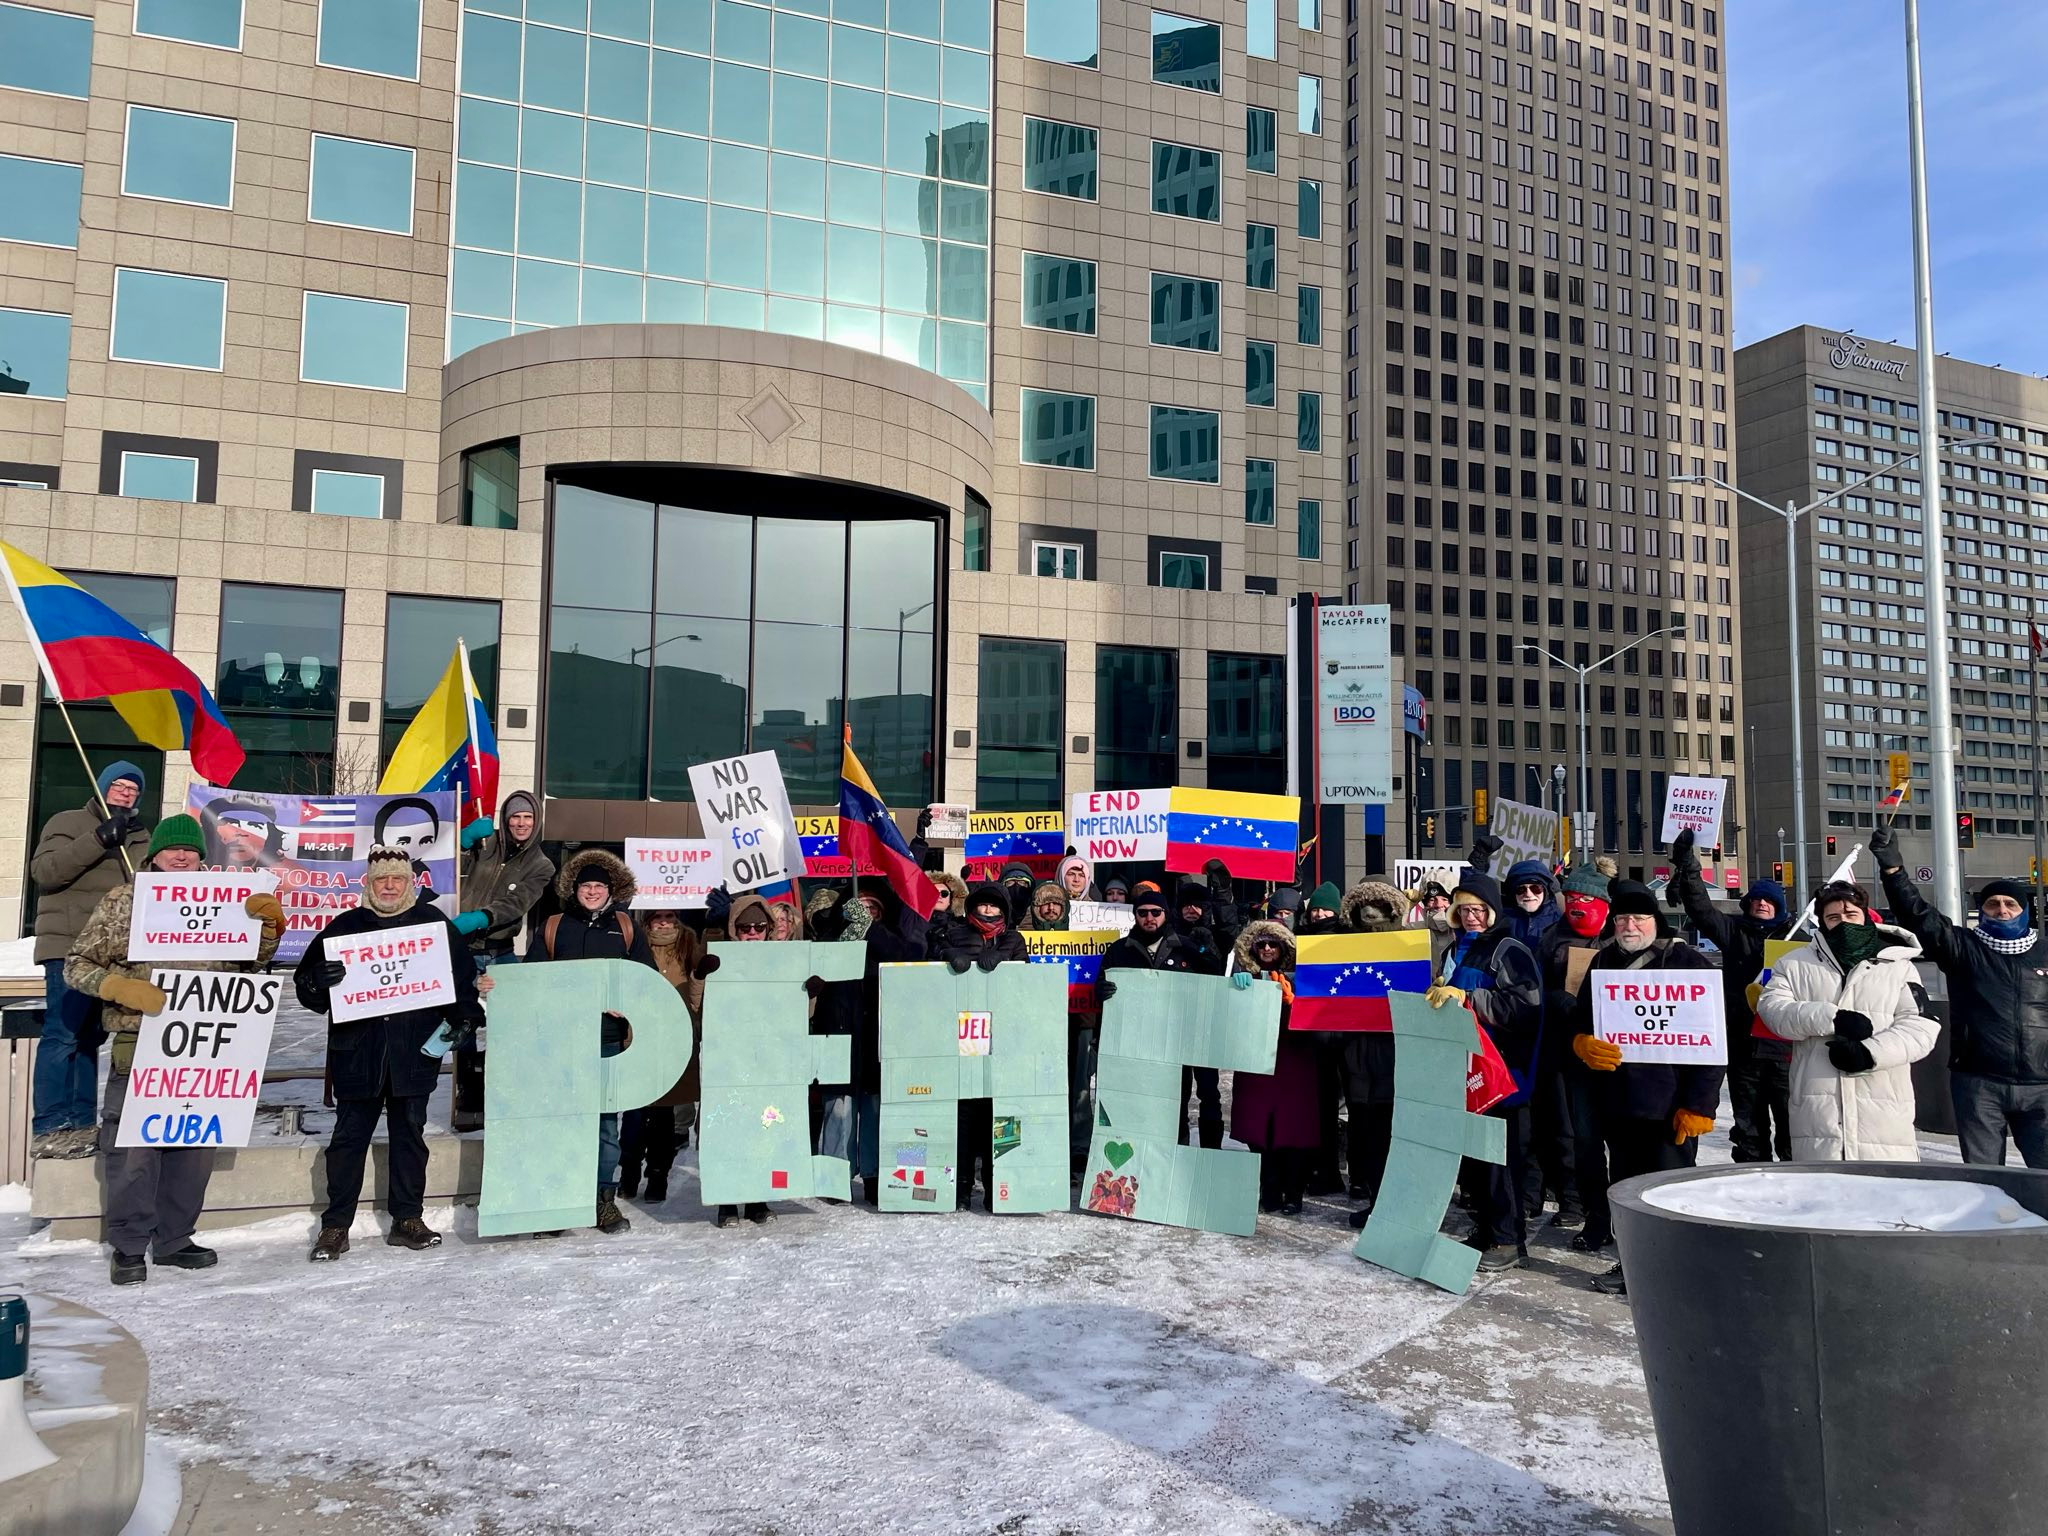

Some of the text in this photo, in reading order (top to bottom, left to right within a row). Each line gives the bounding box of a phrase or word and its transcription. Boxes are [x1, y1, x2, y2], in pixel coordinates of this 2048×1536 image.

[1830, 335, 1910, 381] Fairmont
[1322, 610, 1363, 618] TAYLOR
[1322, 617, 1387, 626] McCAFFREY
[1339, 706, 1376, 719] BDO
[712, 759, 749, 789] NO
[1325, 785, 1375, 797] UPTOWN
[1672, 788, 1717, 801] CARNEY:
[707, 786, 768, 823] WAR
[1089, 791, 1140, 812] END
[1672, 804, 1713, 815] RESPECT
[970, 815, 1058, 832] HANDS OFF!
[1494, 801, 1555, 849] DEMAND
[1669, 813, 1713, 824] INTERNATIONAL
[1678, 821, 1702, 832] LAWS
[732, 827, 764, 849] for
[304, 842, 347, 851] M-26-7
[1090, 838, 1138, 859] NOW
[636, 850, 711, 862] TRUMP
[659, 865, 690, 874] OUT
[665, 876, 684, 884] OF
[152, 886, 251, 902] TRUMP
[637, 886, 713, 895] VENEZUELA
[180, 906, 221, 917] OUT
[1070, 904, 1121, 923] REJECT
[187, 919, 212, 930] OF
[146, 932, 248, 944] VENEZUELA
[339, 938, 433, 965] TRUMP
[370, 959, 409, 975] OUT
[380, 972, 403, 986] OF
[157, 973, 279, 1014] HANDS
[343, 979, 442, 1005] VENEZUELA
[1605, 985, 1706, 1002] TRUMP
[1635, 1005, 1676, 1017] OUT
[1643, 1019, 1669, 1031] OF
[161, 1021, 237, 1059] OFF
[1605, 1033, 1713, 1046] VENEZUELA
[132, 1067, 258, 1099] VENEZUELA
[182, 1102, 193, 1110] +
[141, 1114, 223, 1144] CUBA
